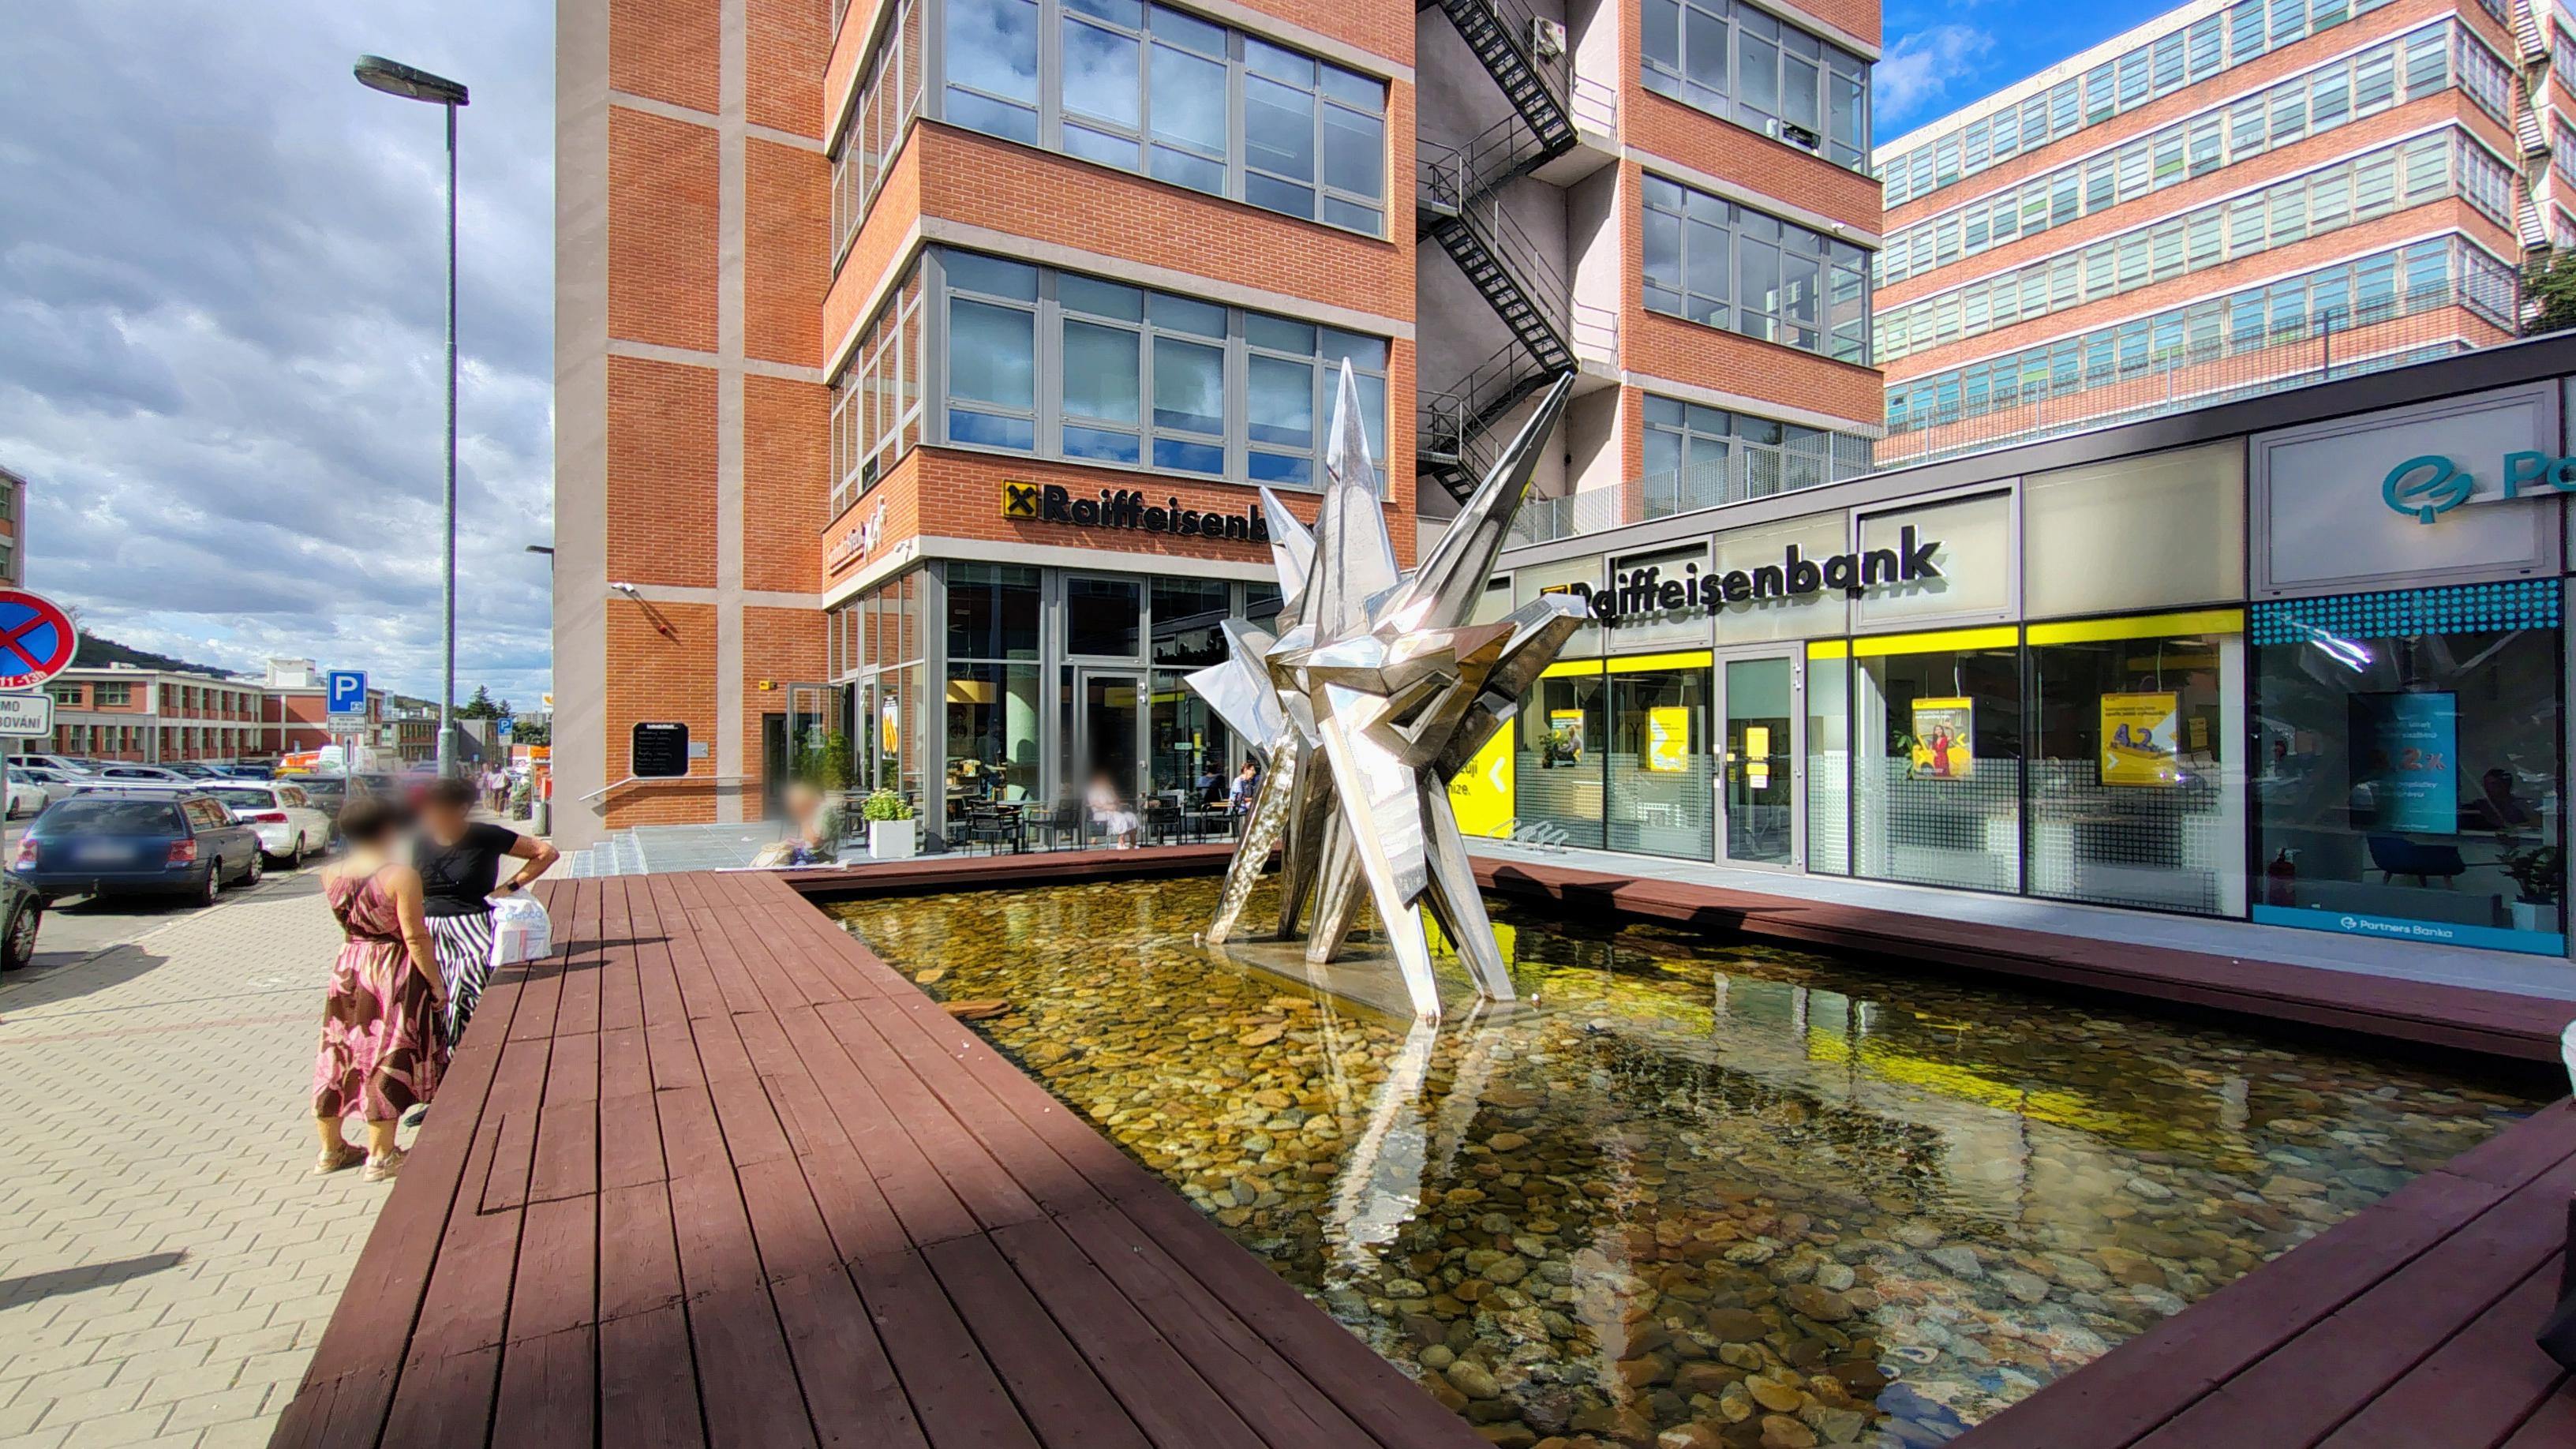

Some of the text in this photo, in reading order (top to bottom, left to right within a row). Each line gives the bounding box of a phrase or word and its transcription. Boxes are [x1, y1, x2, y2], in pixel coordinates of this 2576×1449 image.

[1041, 484, 1314, 541] Raiffeisenb
[335, 676, 358, 701] P
[2360, 919, 2454, 938] Partners Banka
